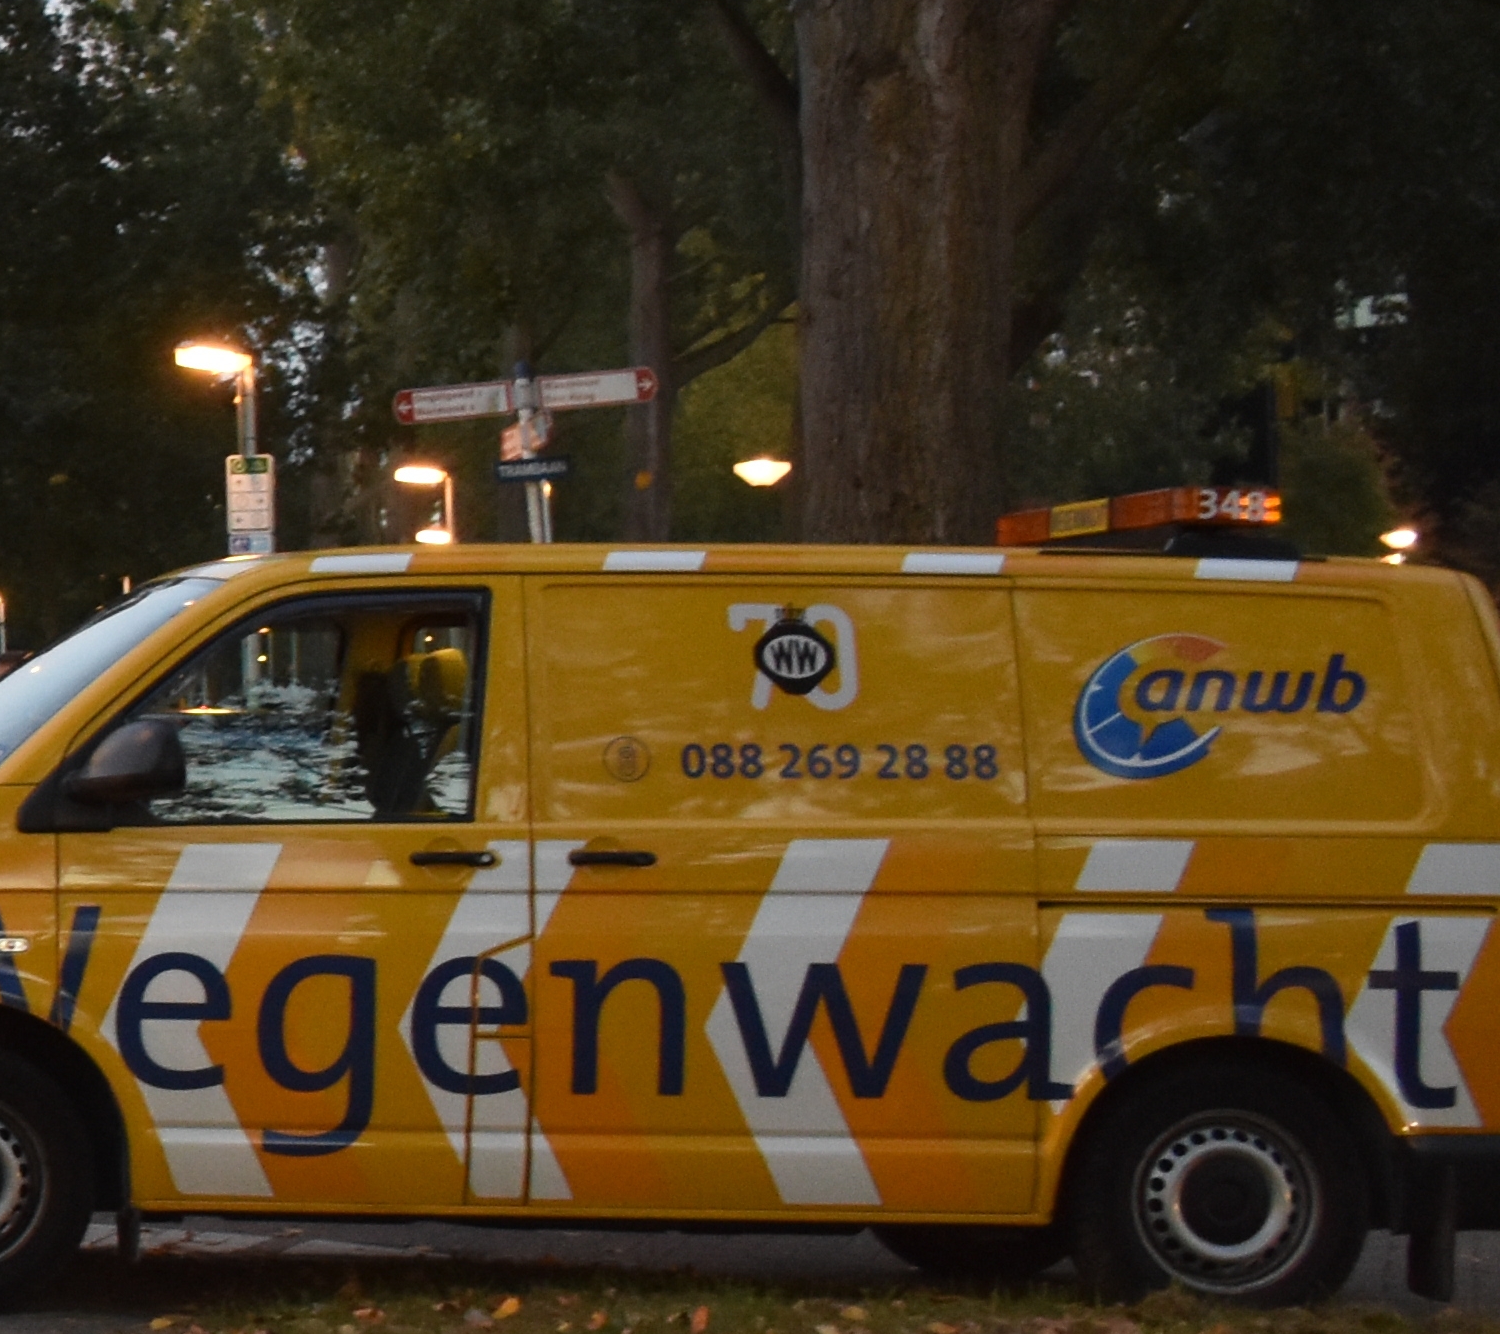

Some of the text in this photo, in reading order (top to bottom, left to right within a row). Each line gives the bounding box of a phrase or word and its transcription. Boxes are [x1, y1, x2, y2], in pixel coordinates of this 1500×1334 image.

[1197, 488, 1267, 522] 348
[1135, 653, 1367, 714] anwb
[681, 743, 999, 779] 088 269 28 88
